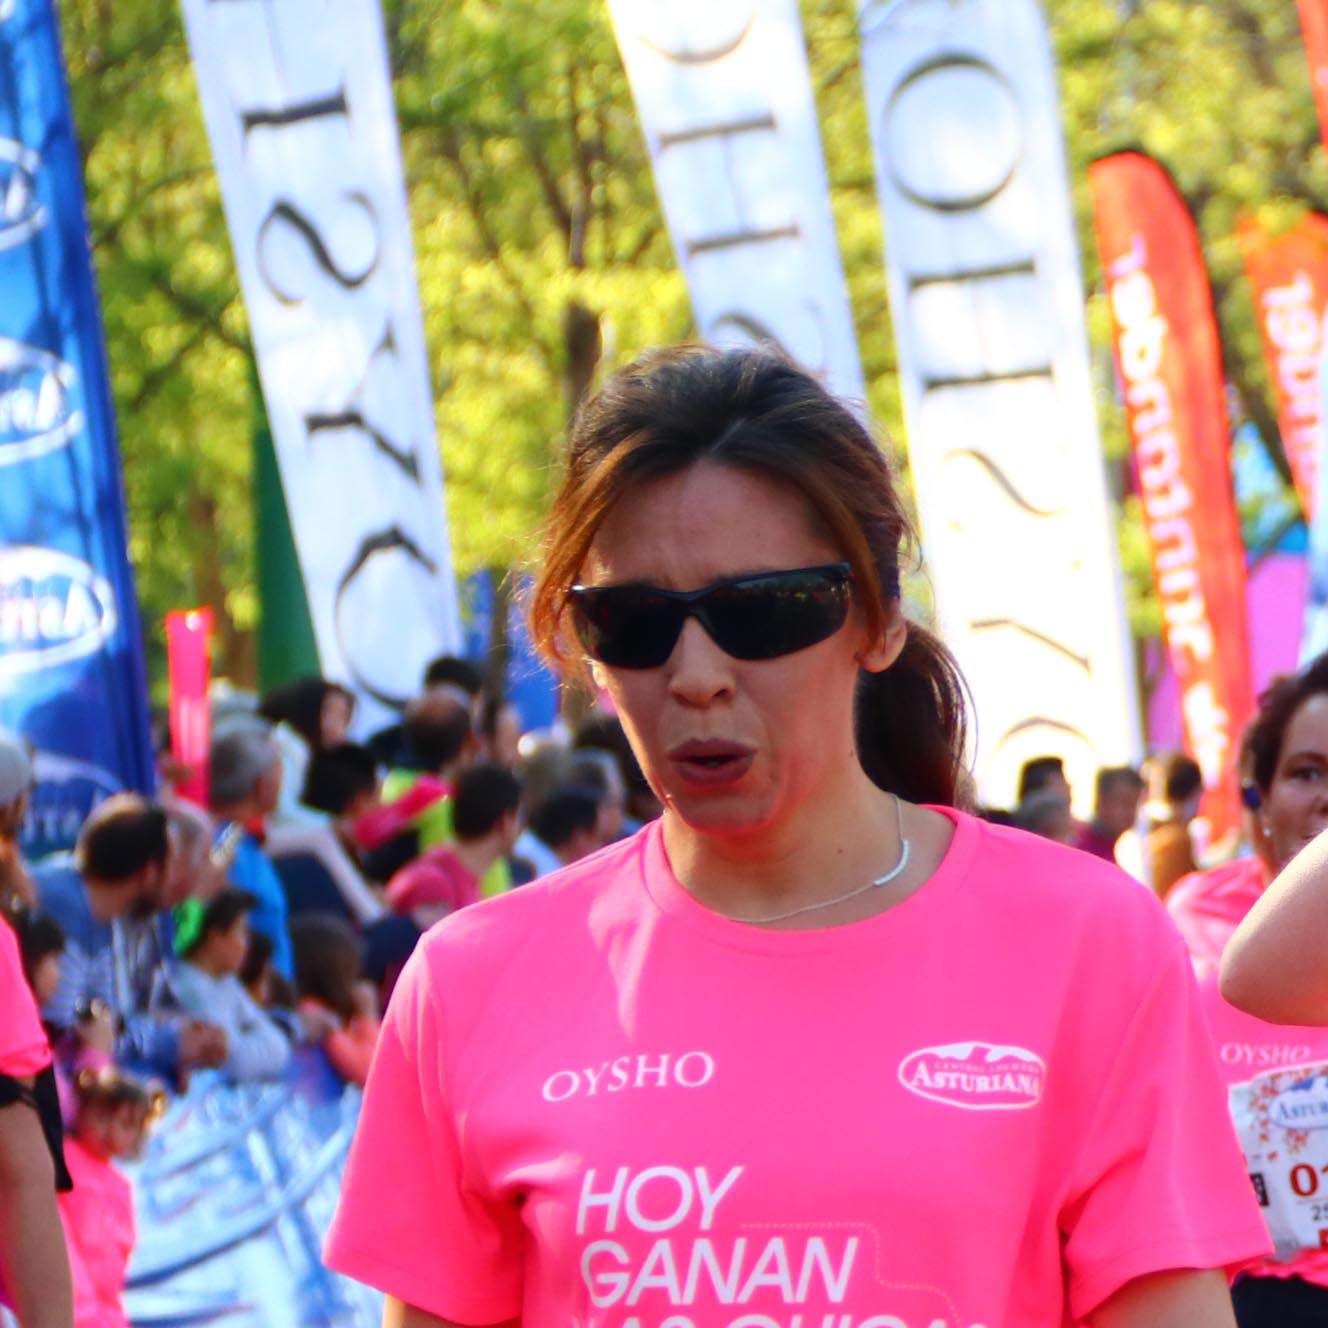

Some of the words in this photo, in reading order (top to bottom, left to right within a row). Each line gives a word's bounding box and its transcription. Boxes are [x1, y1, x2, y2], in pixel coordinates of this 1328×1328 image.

[541, 1051, 714, 1101] OYSHO
[1221, 1042, 1310, 1065] OYSHO
[576, 1165, 745, 1235] HOY
[580, 1237, 858, 1307] GANAN
